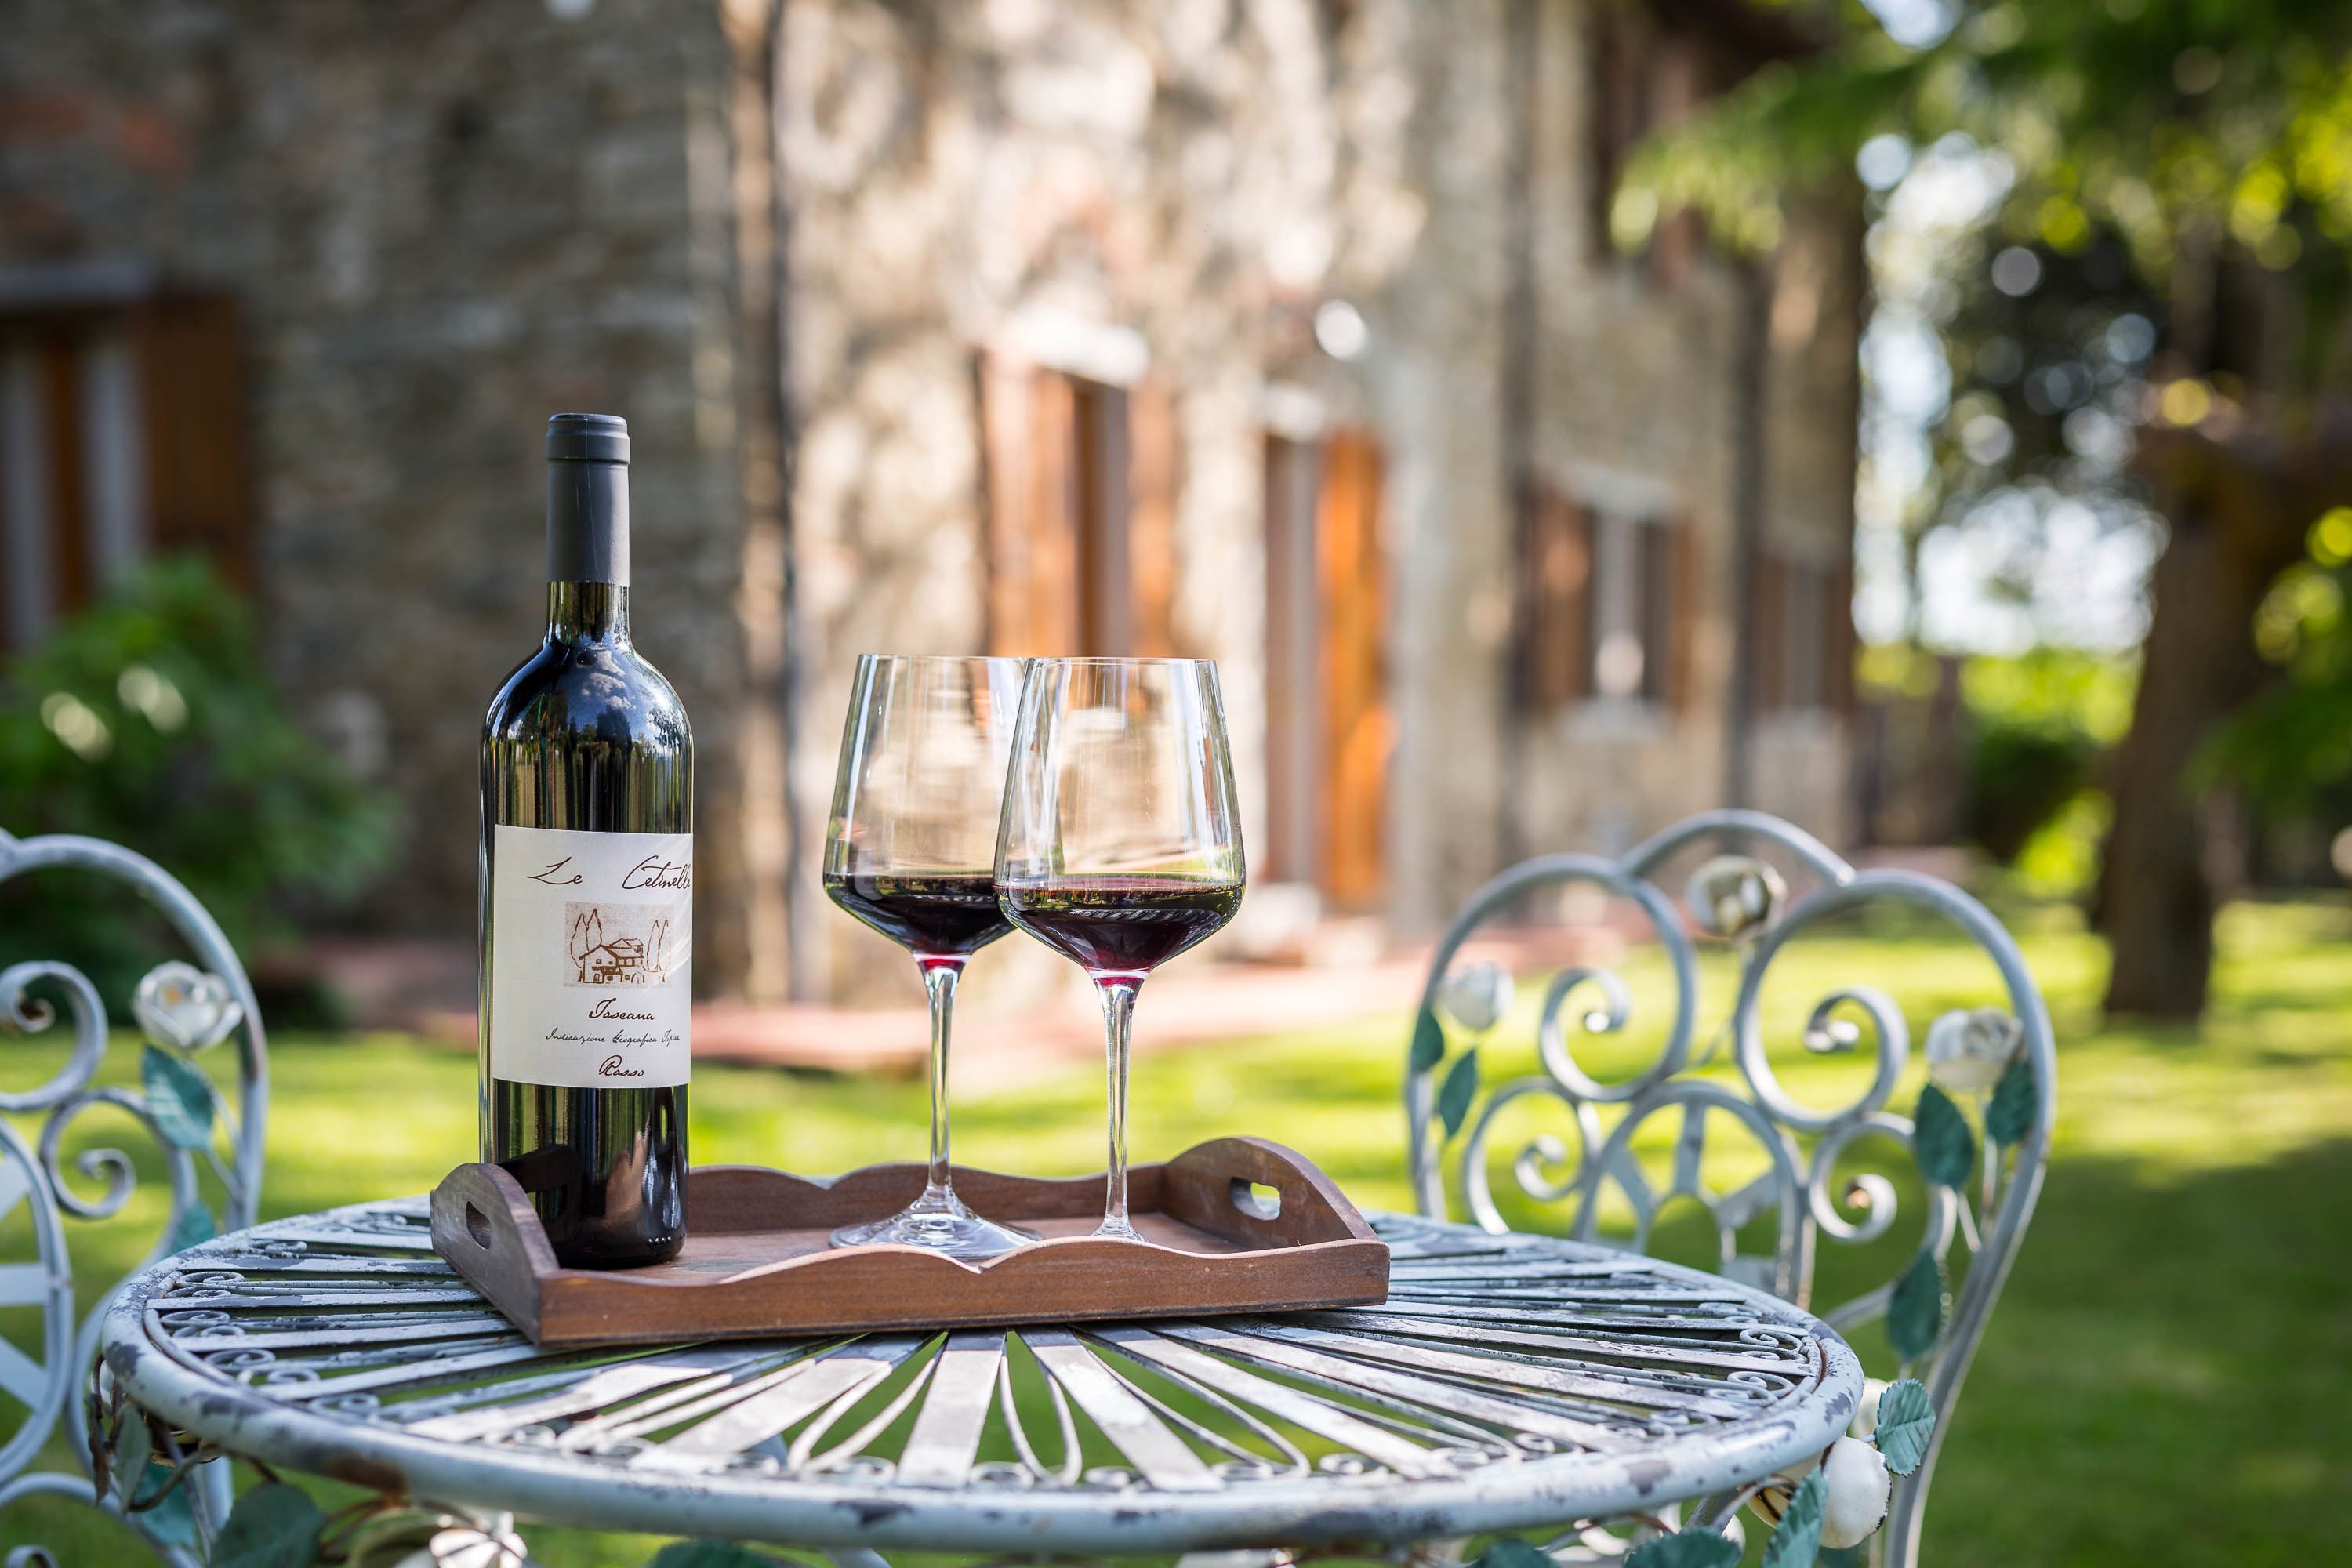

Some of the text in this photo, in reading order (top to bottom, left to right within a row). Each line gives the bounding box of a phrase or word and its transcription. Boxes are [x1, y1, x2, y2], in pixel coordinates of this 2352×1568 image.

[527, 856, 583, 884] Le
[589, 998, 655, 1021] Toscana
[546, 1027, 606, 1044] Indicazione
[612, 1029, 657, 1047] Geografica
[598, 1055, 644, 1077] Rosso
